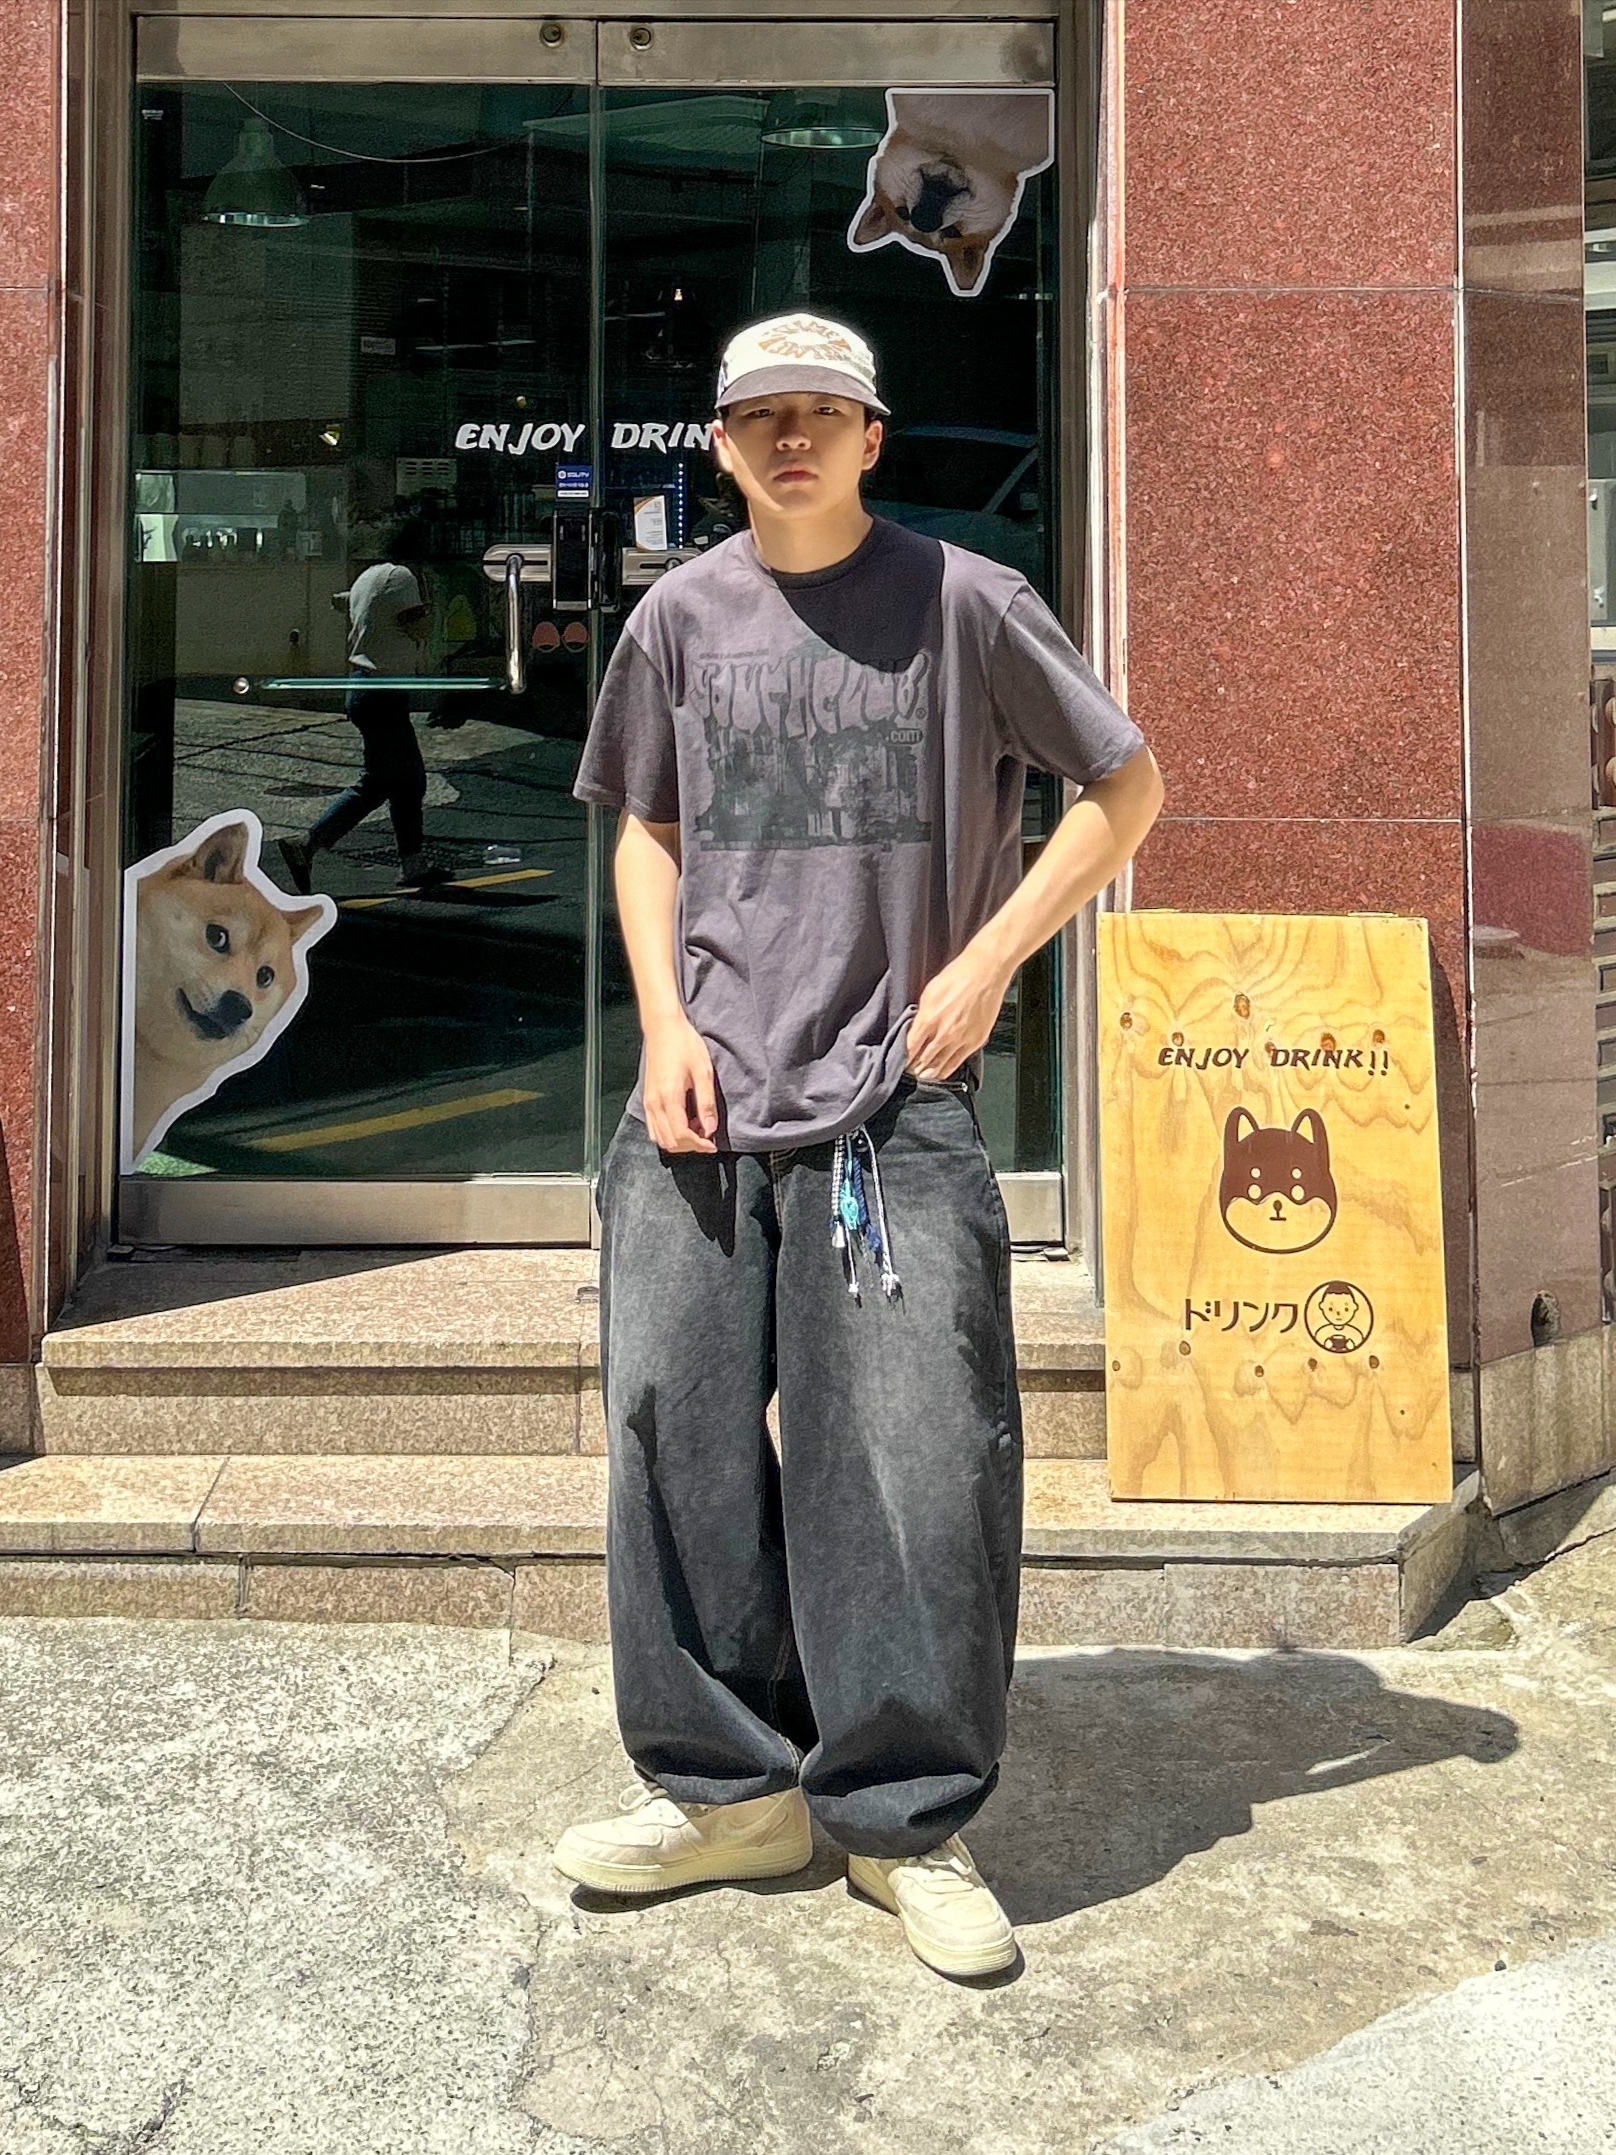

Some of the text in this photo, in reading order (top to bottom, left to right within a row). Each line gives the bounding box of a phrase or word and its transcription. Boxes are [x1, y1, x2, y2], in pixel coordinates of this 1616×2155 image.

[455, 422, 585, 454] ENJOY
[1158, 1047, 1389, 1076] ENJOY DRINK!!
[1184, 1298, 1298, 1333] ドリンク
